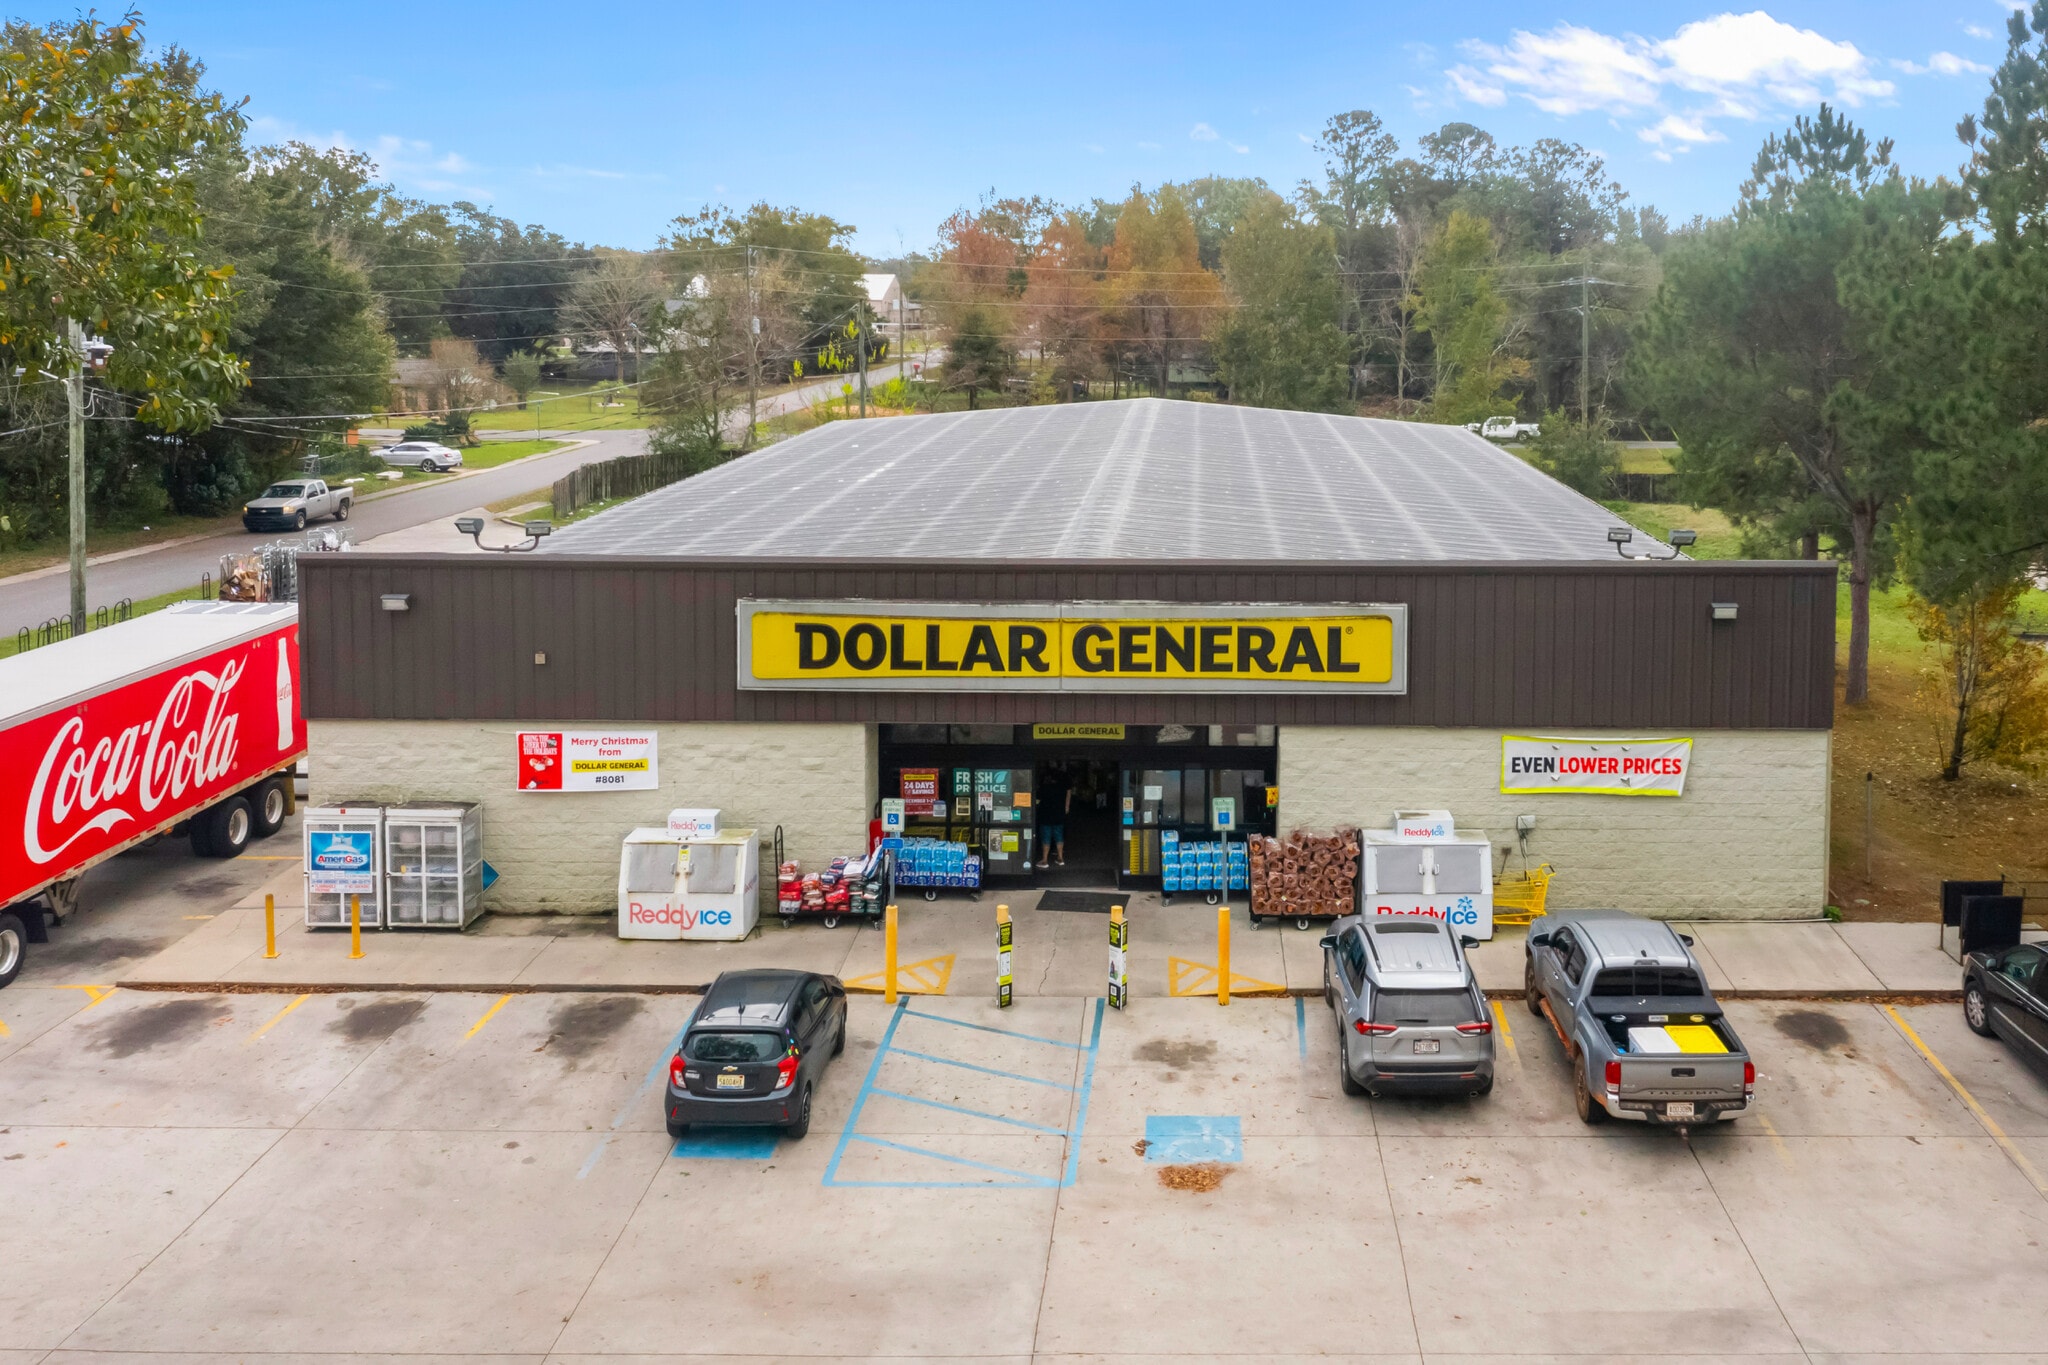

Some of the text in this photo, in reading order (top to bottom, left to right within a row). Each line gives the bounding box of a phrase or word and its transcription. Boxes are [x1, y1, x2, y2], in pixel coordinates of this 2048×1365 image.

[794, 622, 1361, 673] DOLLAR GENERAL
[1038, 726, 1121, 735] DOLLAR GENERAL
[571, 737, 649, 746] Merry Christmas
[598, 748, 622, 756] from
[24, 653, 248, 865] Coca-Cola
[1511, 757, 1682, 774] EVEN LOWER PRICES
[595, 775, 625, 784] #8081
[904, 781, 935, 789] 24 DAYS
[956, 784, 1007, 793] PRDUCE
[317, 855, 364, 863] AmeriGas
